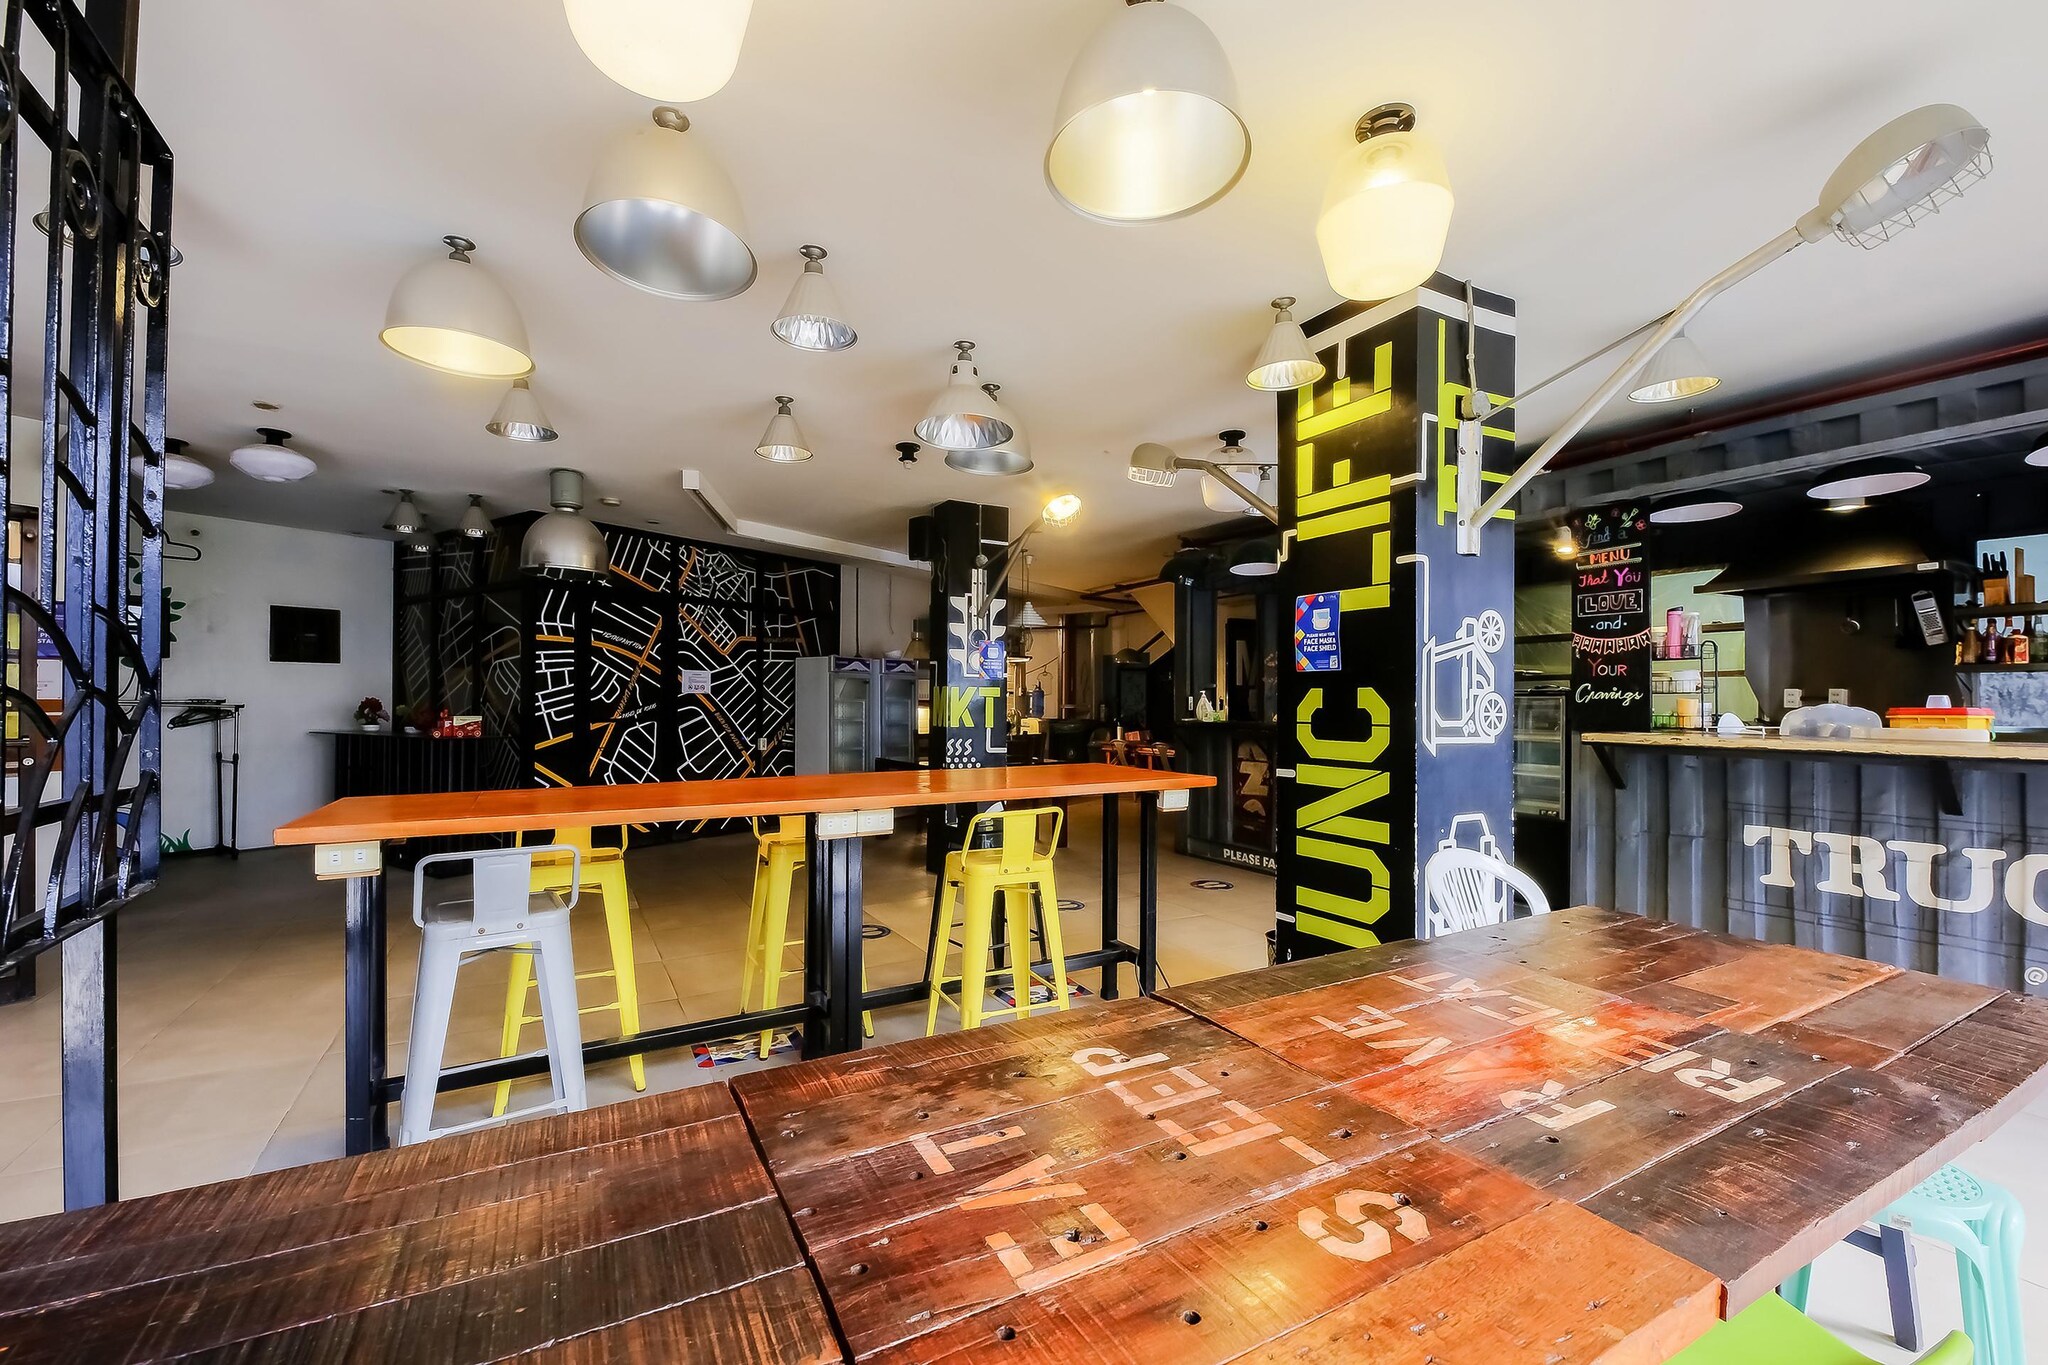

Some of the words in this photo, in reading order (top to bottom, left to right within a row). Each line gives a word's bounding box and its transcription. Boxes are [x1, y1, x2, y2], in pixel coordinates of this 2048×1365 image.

[1589, 549, 1631, 564] MENU
[1578, 569, 1610, 587] That
[1585, 593, 1638, 612] LOVE
[1575, 683, 1644, 706] Cravings
[932, 686, 1000, 728] MKT
[1223, 848, 1260, 866] PLEASE
[1071, 1046, 1430, 1262] SLEEP
[909, 1126, 1147, 1293] EAT
